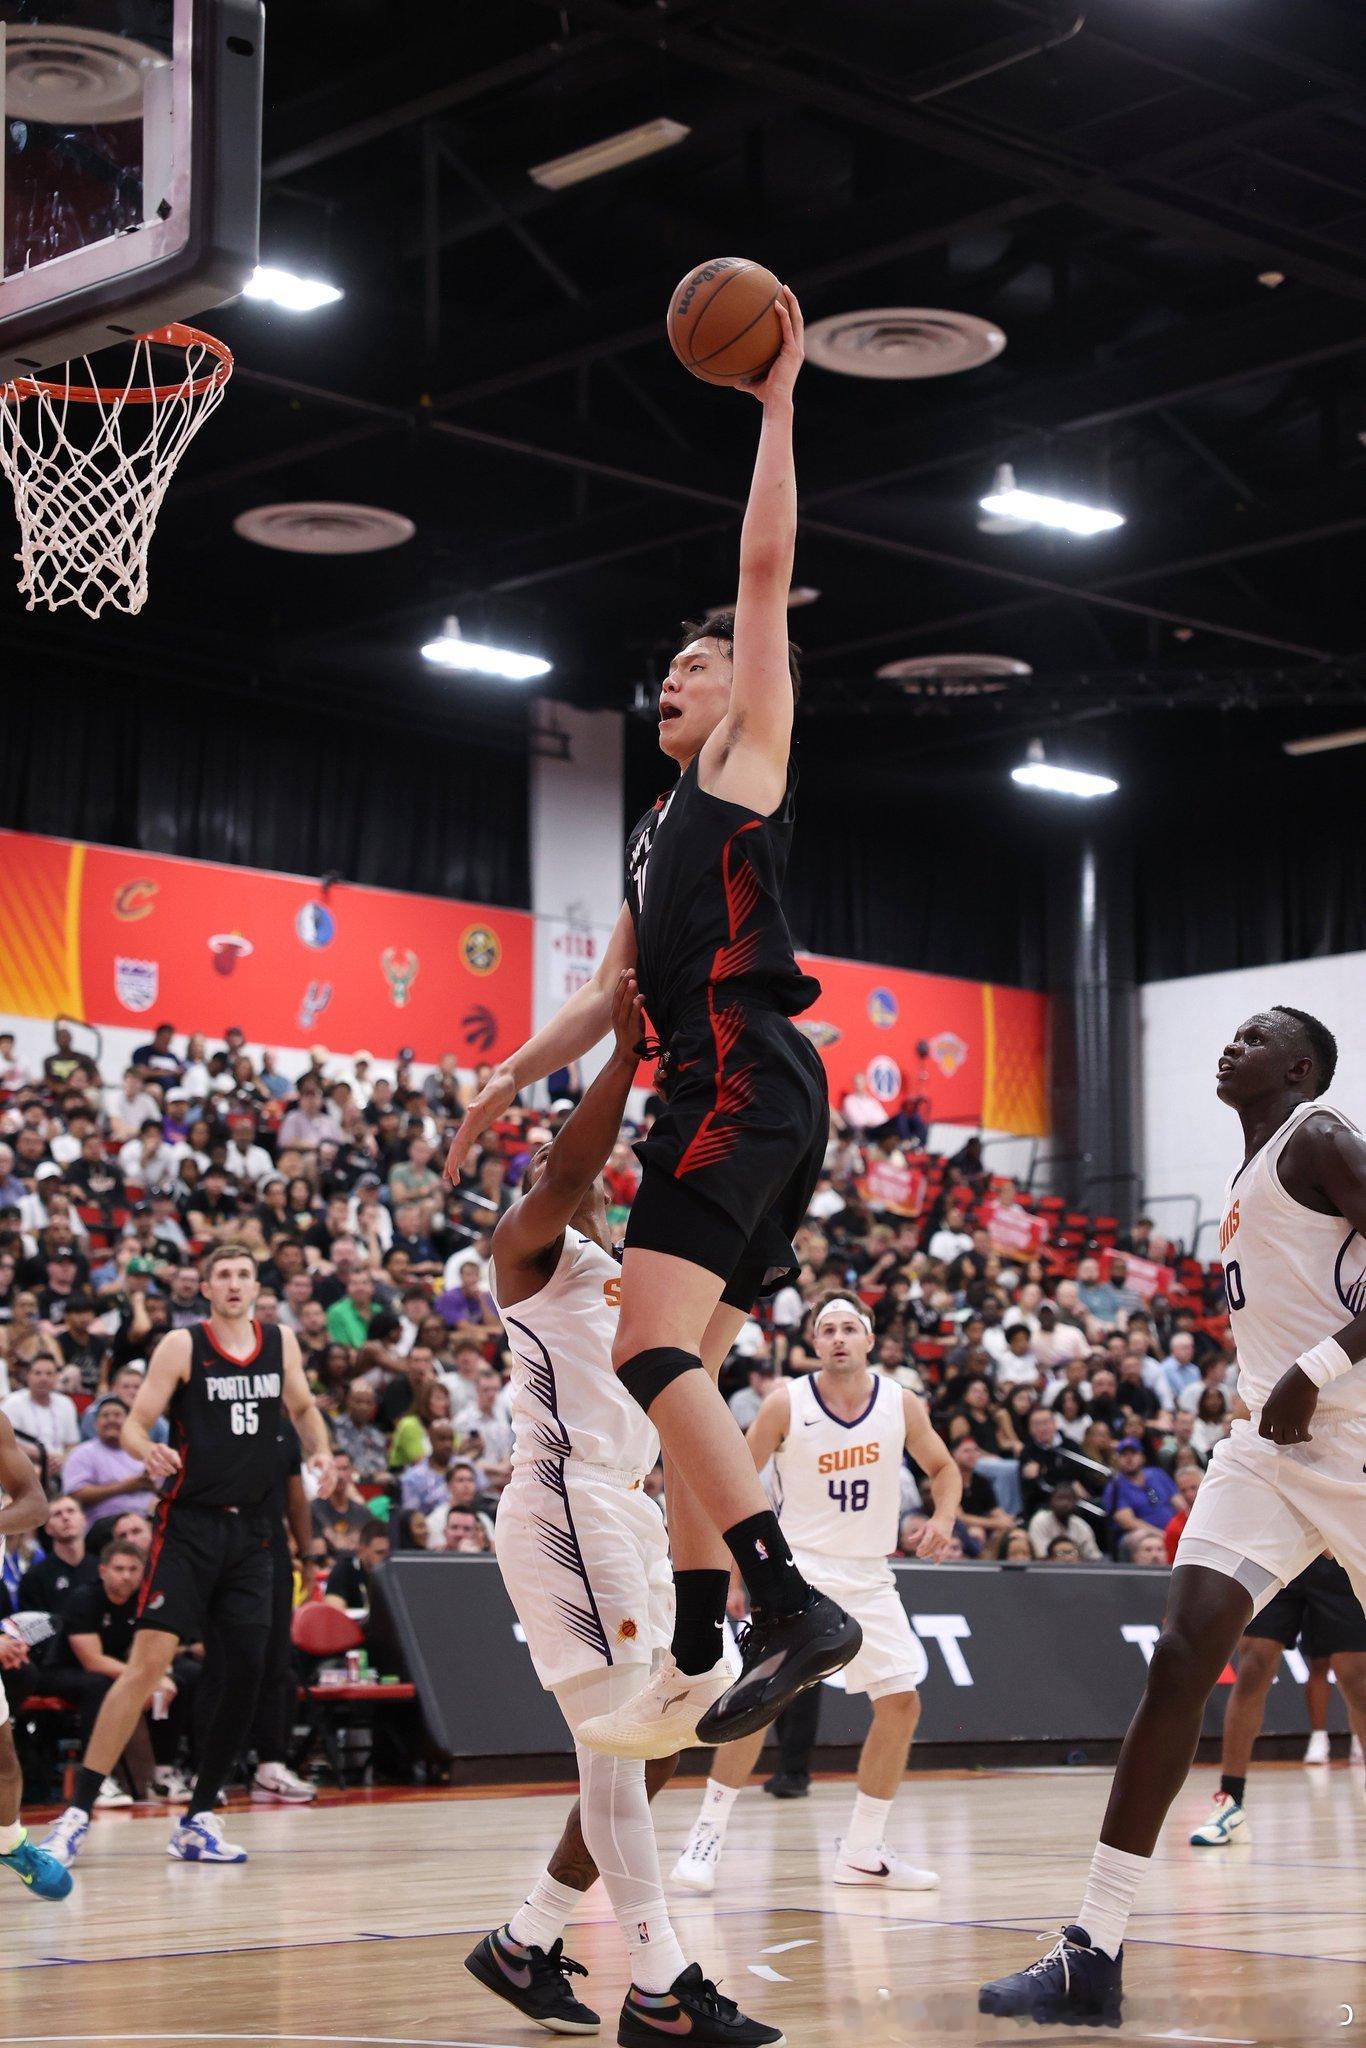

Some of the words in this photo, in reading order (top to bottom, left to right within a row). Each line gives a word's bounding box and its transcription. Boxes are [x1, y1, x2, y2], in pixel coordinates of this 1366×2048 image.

[1223, 1259, 1246, 1311] 0
[205, 1372, 281, 1402] PORTLAND
[230, 1401, 259, 1436] 65
[817, 1441, 880, 1475] SUNS
[827, 1479, 869, 1512] 48
